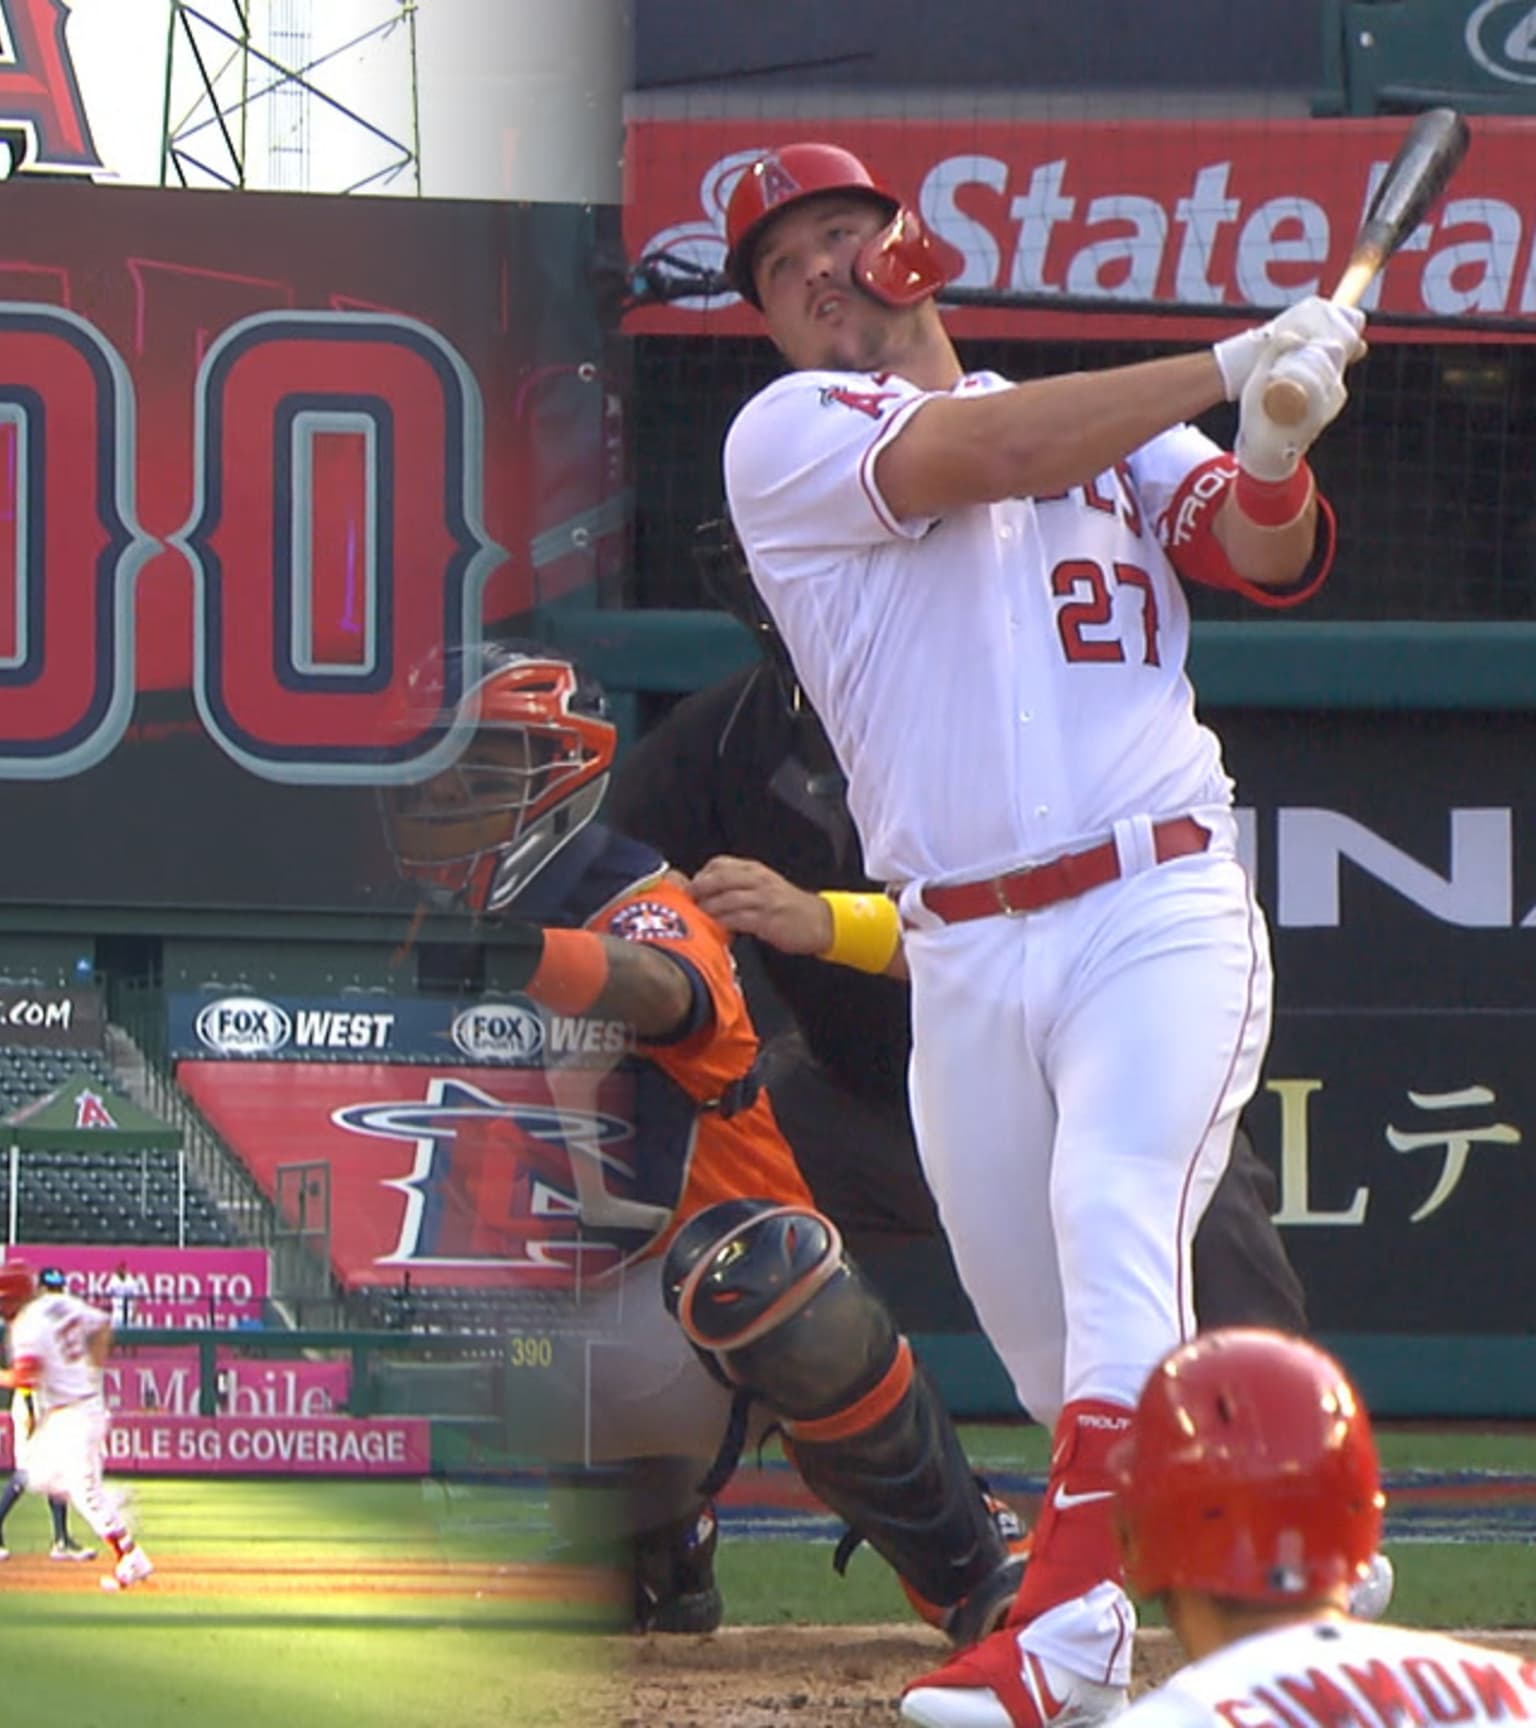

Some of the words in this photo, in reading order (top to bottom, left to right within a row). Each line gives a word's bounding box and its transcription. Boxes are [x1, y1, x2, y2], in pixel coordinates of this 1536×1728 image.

[918, 153, 1330, 306] State
[1051, 559, 1161, 668] 27
[217, 1011, 268, 1035] FOX
[295, 1012, 394, 1048] WEST
[473, 1015, 523, 1039] FOX
[207, 1274, 252, 1305] TO
[511, 1336, 553, 1367] 390
[179, 1429, 221, 1460] 5G
[228, 1430, 406, 1462] COVERAGE
